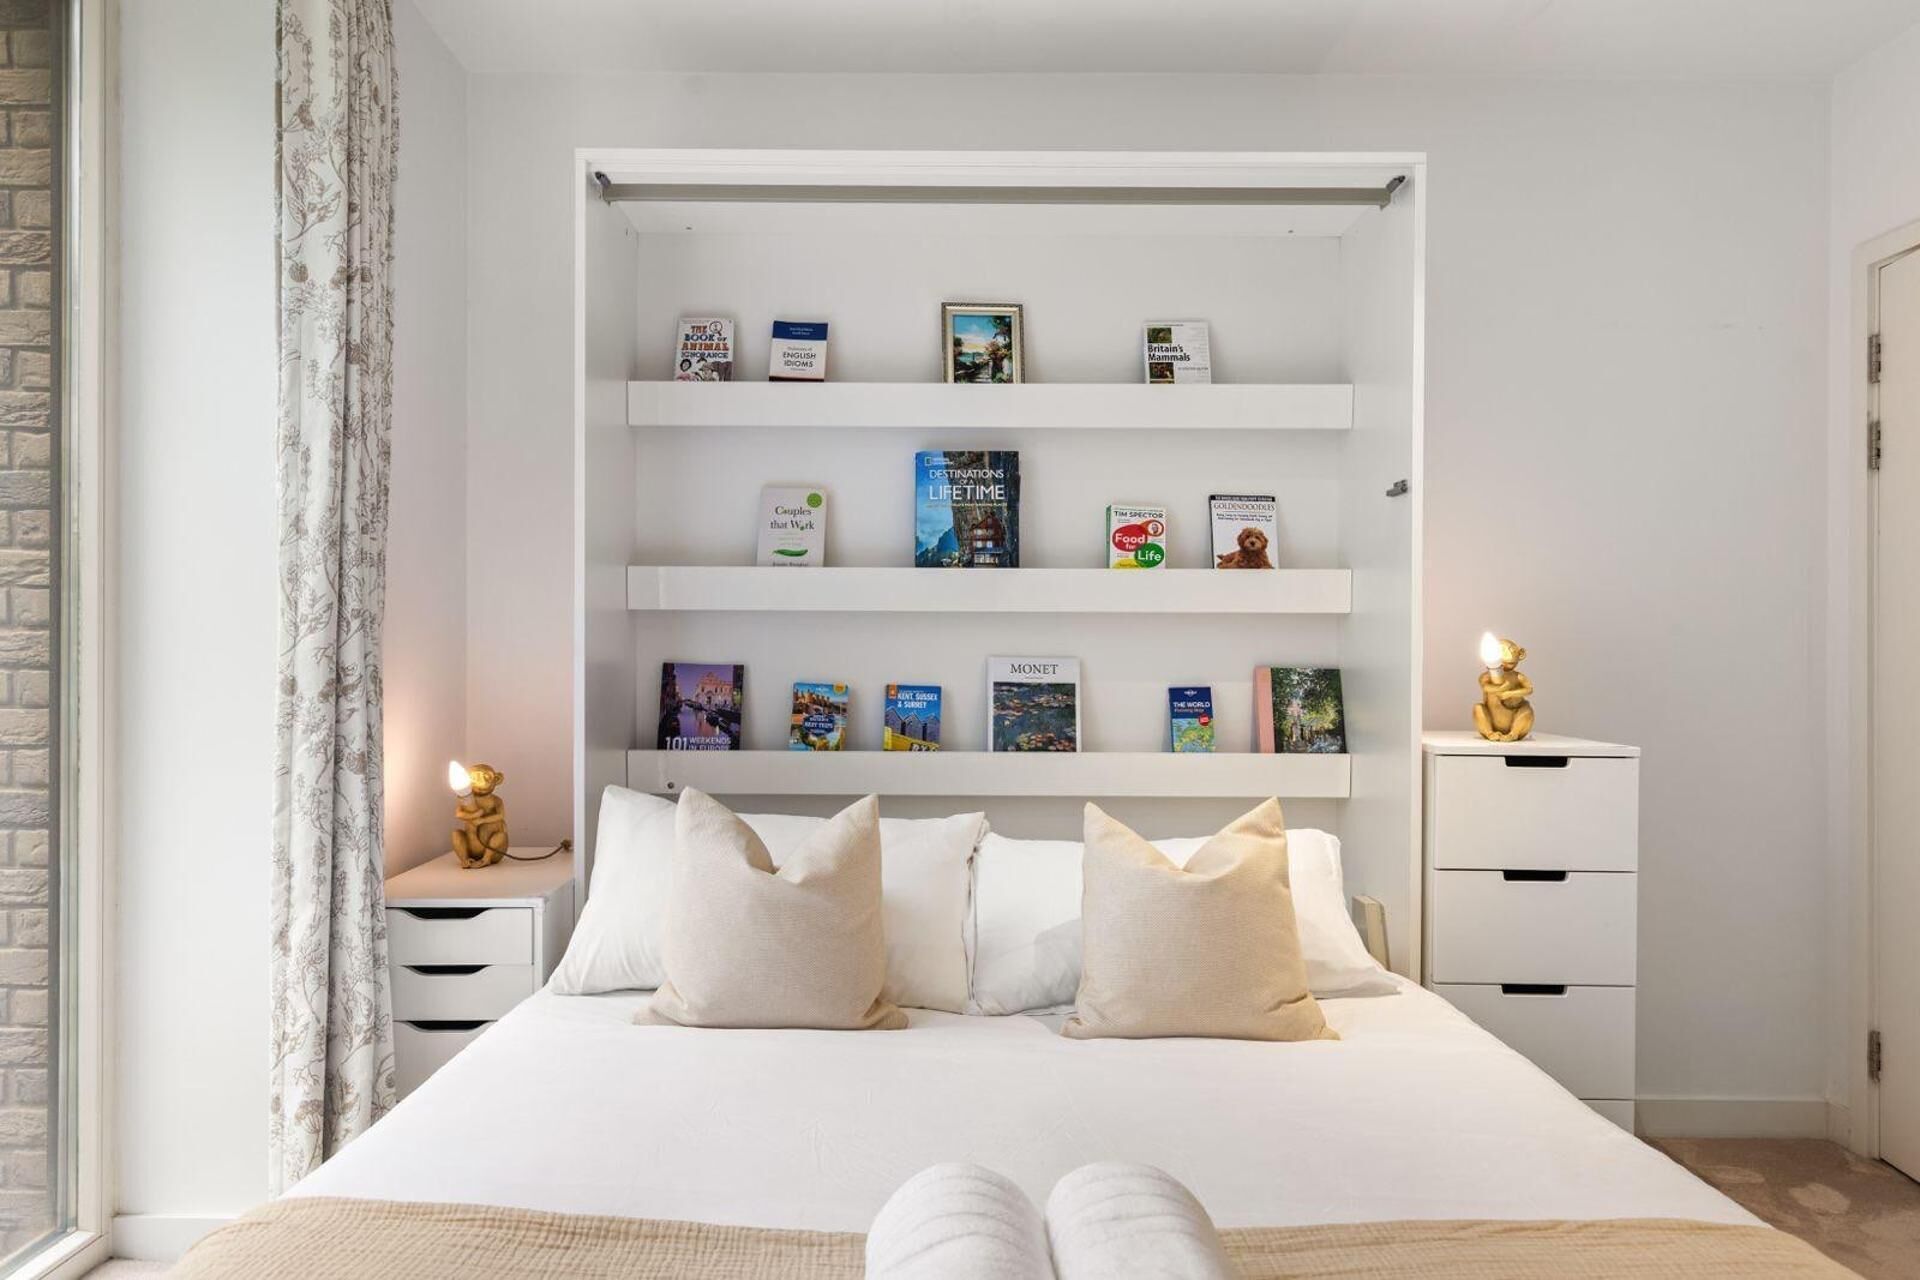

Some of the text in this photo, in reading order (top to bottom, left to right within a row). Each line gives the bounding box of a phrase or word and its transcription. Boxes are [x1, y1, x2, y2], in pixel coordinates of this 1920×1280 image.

[691, 325, 708, 333] THE
[681, 342, 729, 351] ANIMAL
[1147, 344, 1183, 353] Britain's
[681, 351, 728, 359] IGNORANCE
[783, 351, 816, 359] ENGLISH
[1147, 352, 1190, 361] Mammals
[929, 469, 1005, 478] DESTINATIONS
[929, 485, 1006, 500] LIFETIME
[775, 505, 812, 517] Couples
[1213, 502, 1275, 511] GOLDENDOODLES
[770, 520, 788, 529] that
[1115, 533, 1146, 544] Food
[1137, 550, 1162, 561] Life
[1010, 663, 1058, 675] MONET
[665, 736, 732, 750] 101 WEEKENDS
